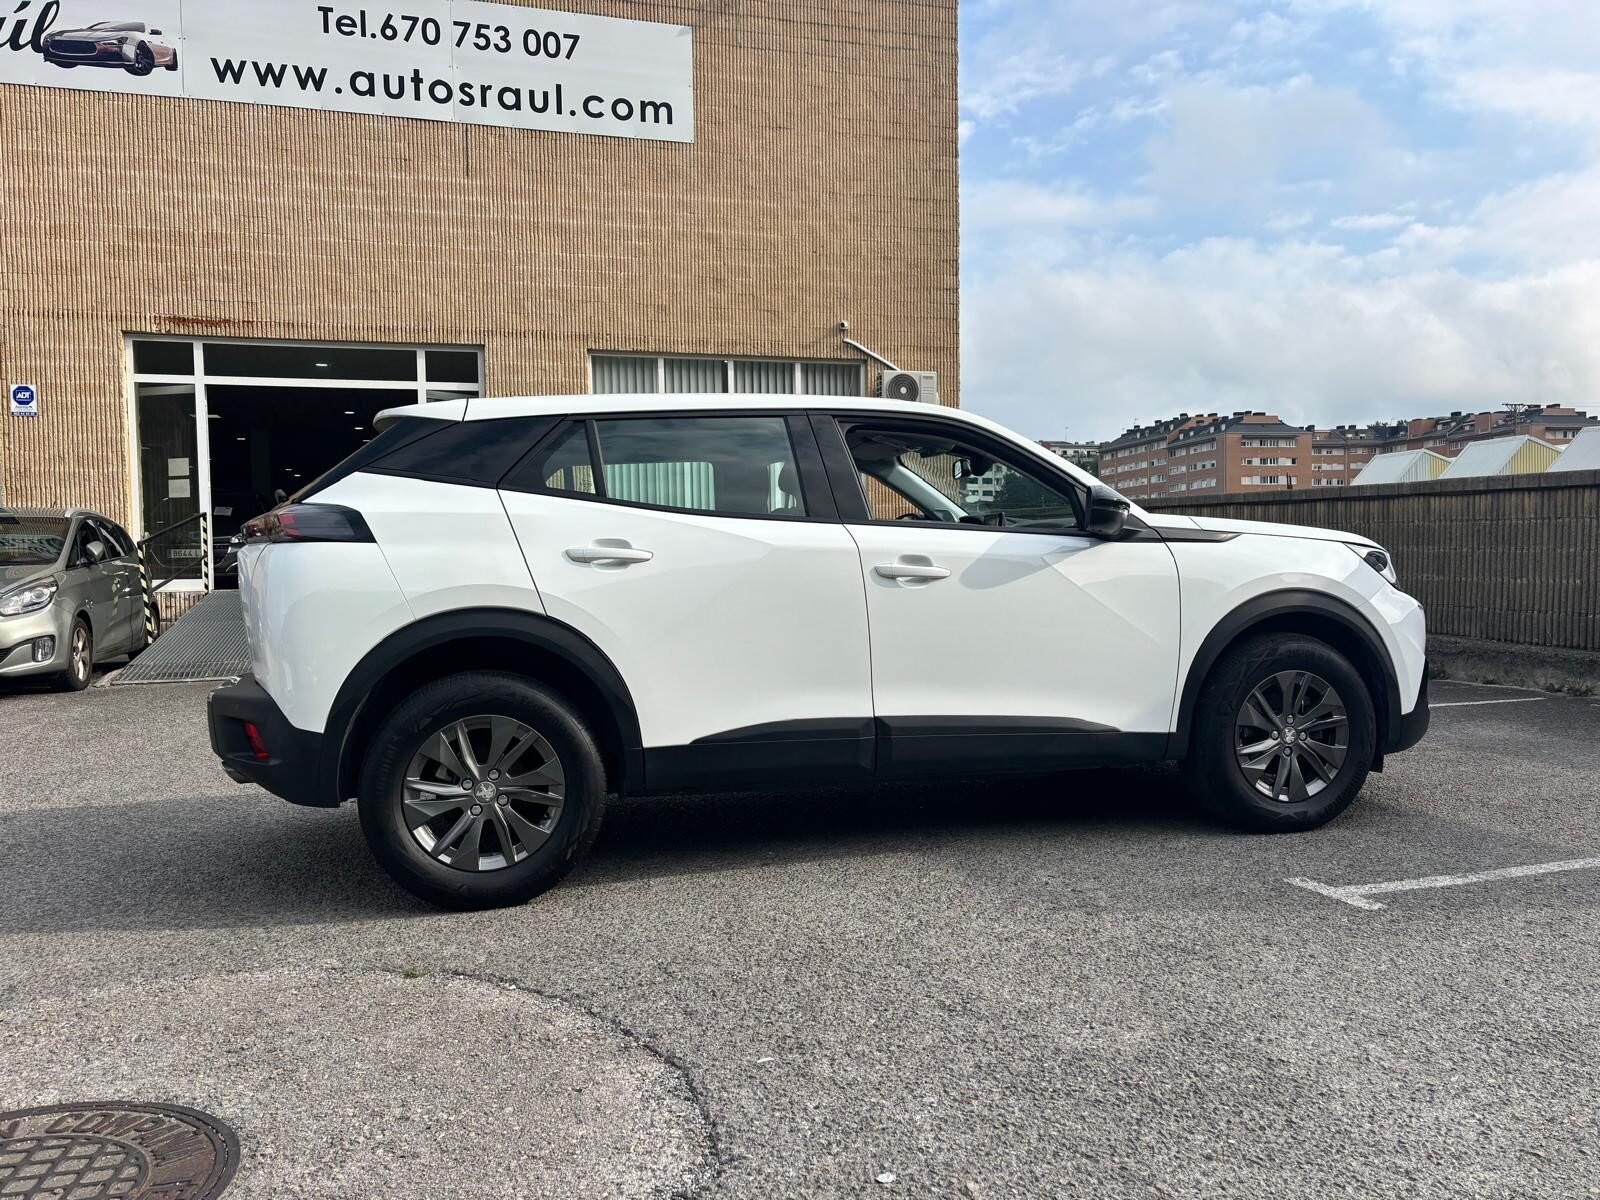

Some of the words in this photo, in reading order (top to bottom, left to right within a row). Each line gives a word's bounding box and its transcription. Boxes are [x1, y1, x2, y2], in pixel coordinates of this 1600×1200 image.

[0, 0, 60, 53] úl
[452, 20, 512, 53] 753
[522, 28, 581, 60] 007
[210, 57, 673, 125] www.autosraul.com
[15, 391, 31, 399] ADT
